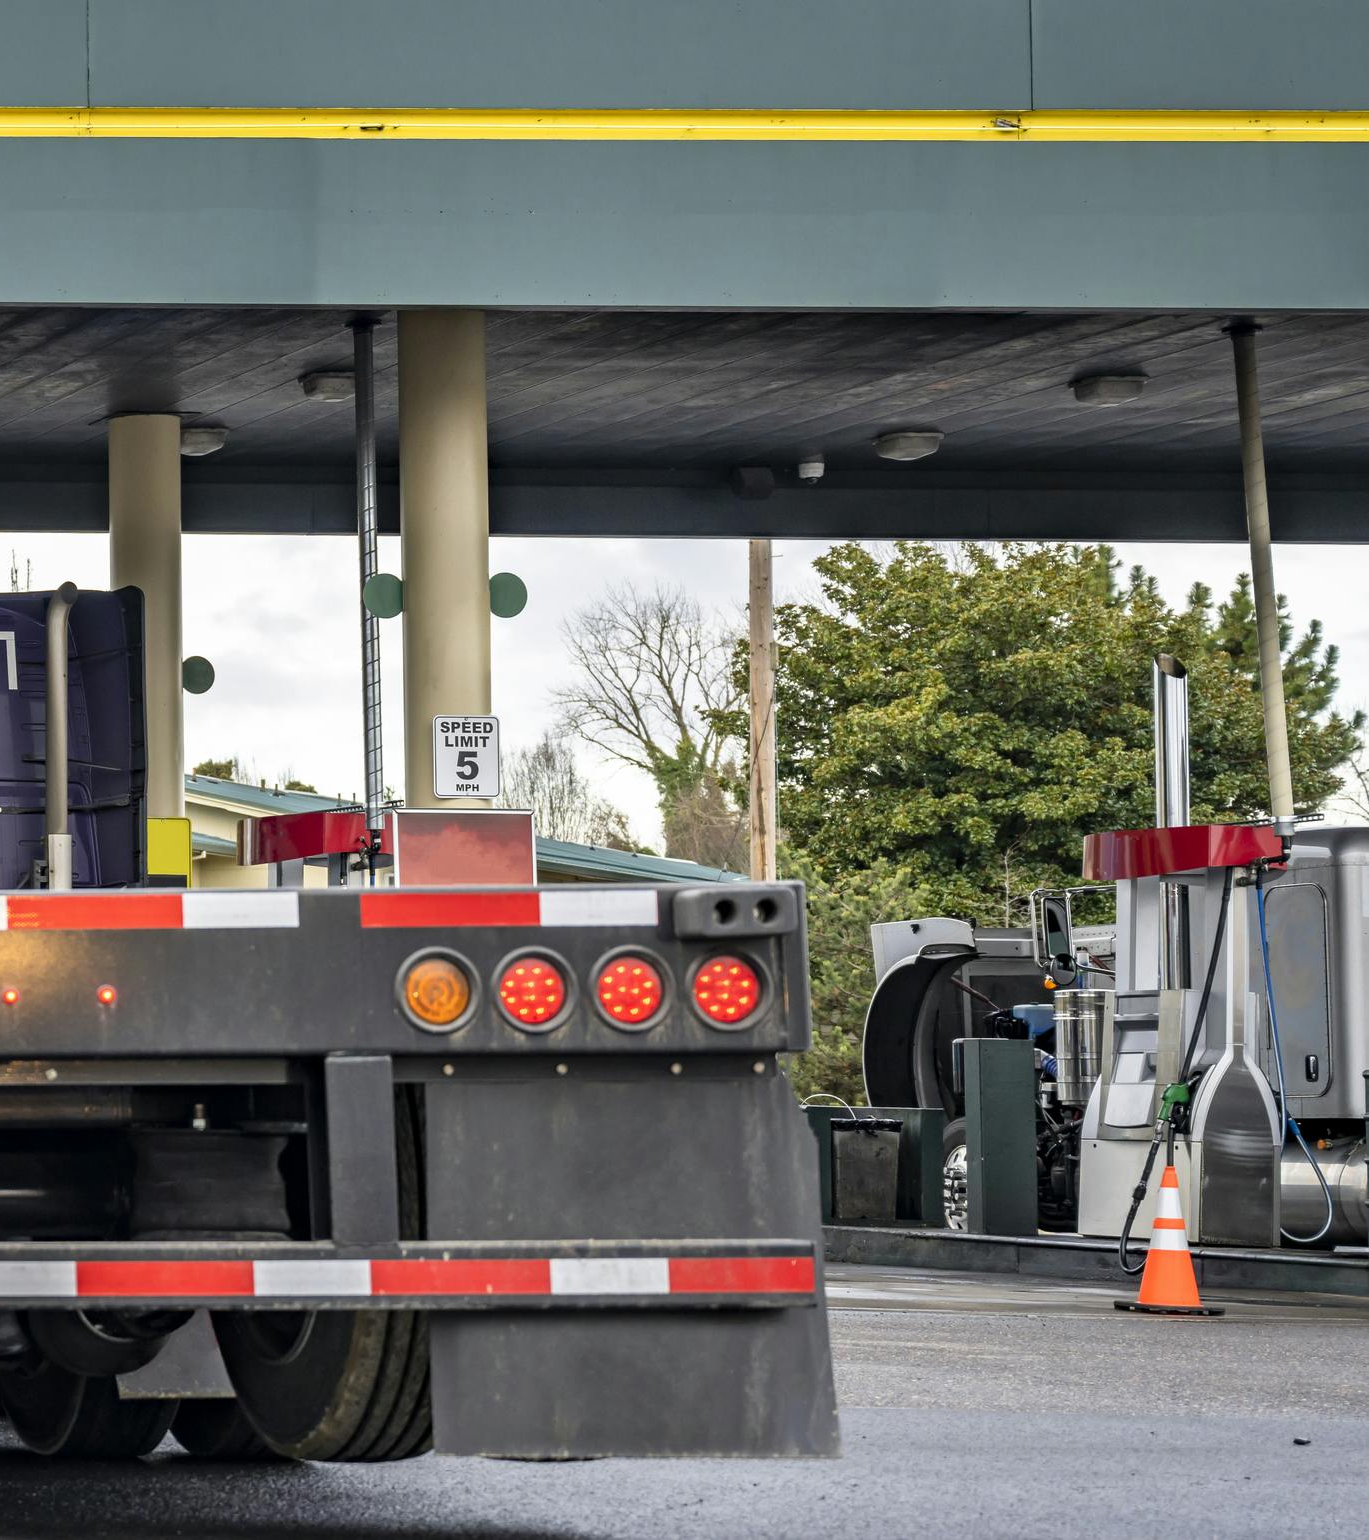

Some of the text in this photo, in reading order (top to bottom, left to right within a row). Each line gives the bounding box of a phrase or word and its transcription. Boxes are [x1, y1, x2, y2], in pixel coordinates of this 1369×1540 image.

[440, 721, 493, 733] SPEED
[445, 736, 490, 747] LIMIT
[456, 751, 479, 781] 5
[456, 784, 479, 792] MPH
